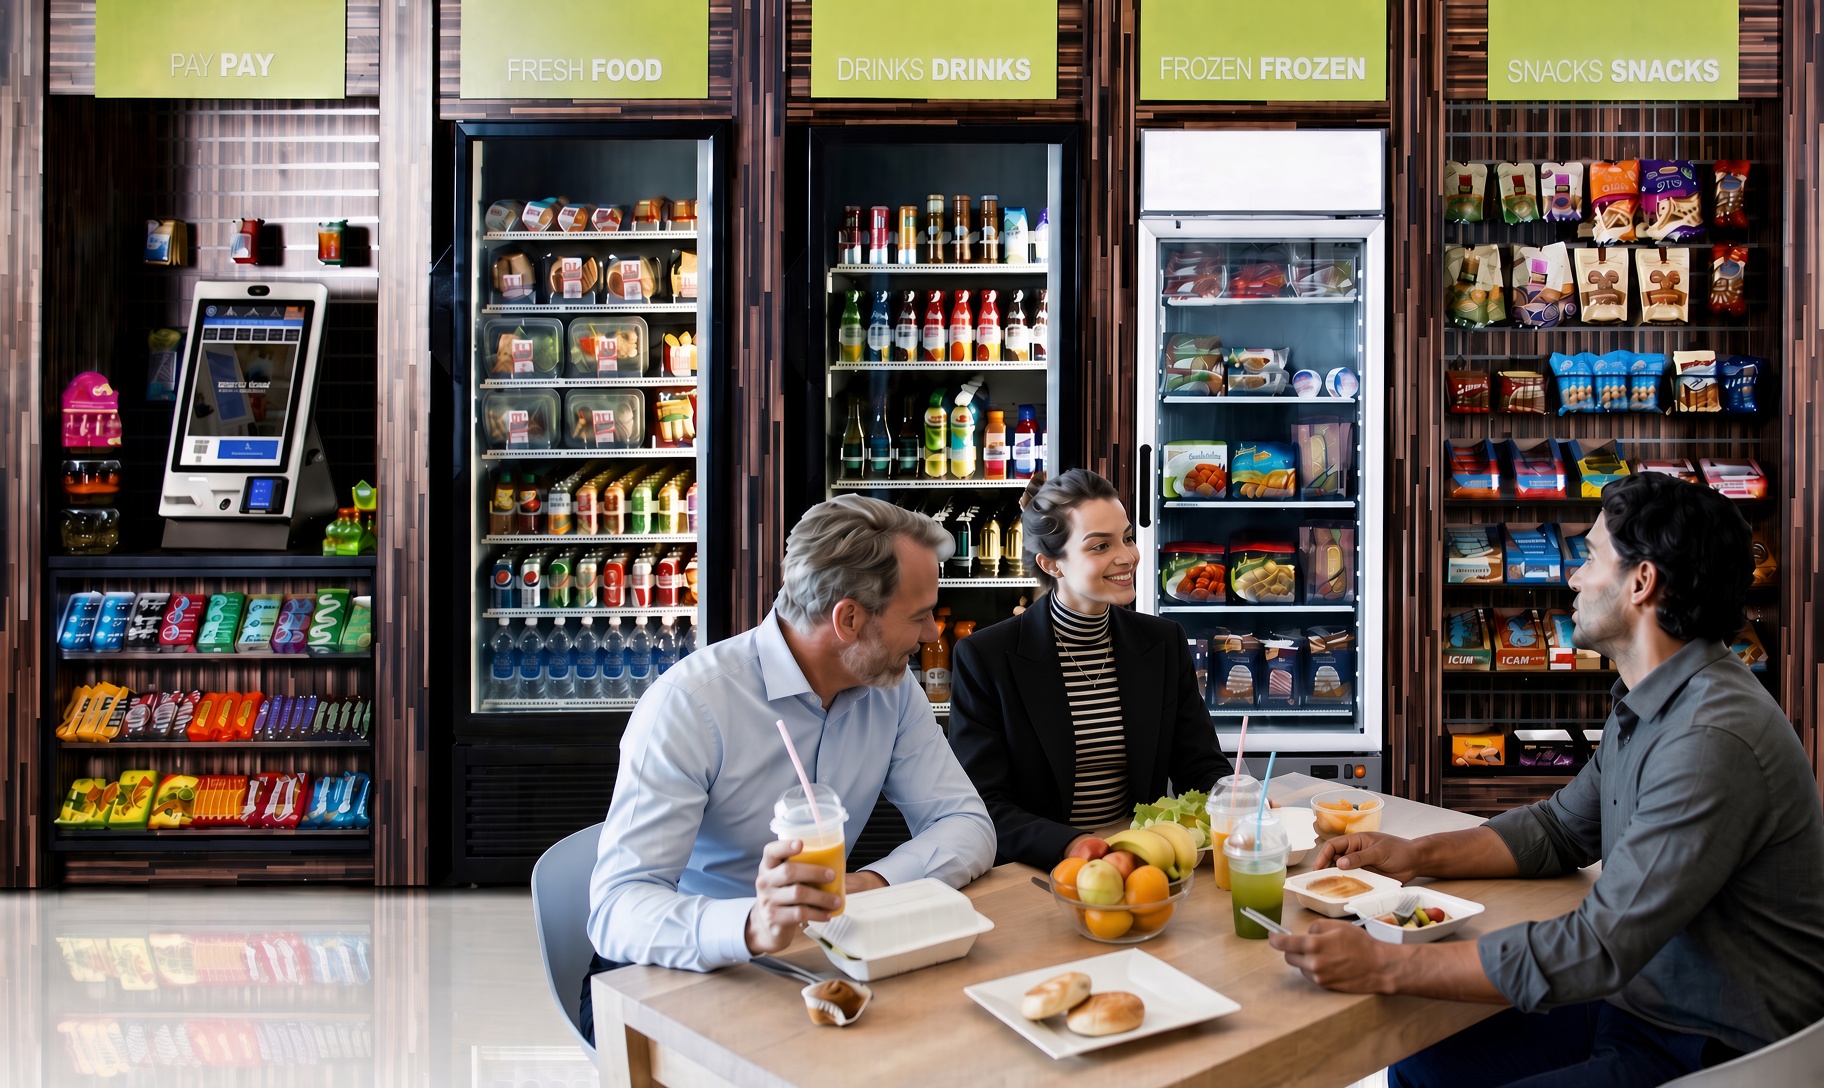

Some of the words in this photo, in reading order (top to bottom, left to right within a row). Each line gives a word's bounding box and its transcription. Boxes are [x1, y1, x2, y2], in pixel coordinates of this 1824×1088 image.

[171, 52, 214, 77] PAY
[220, 52, 275, 77] PAY
[507, 58, 584, 82] FRESH
[591, 58, 663, 82] FOOD
[837, 57, 924, 81] DRINKS
[931, 57, 1031, 81] DRINKS
[1159, 56, 1252, 80] FROZEN
[1259, 56, 1366, 80] FROZEN
[1507, 59, 1603, 83] SNACKS
[1610, 59, 1720, 83] SNACKS
